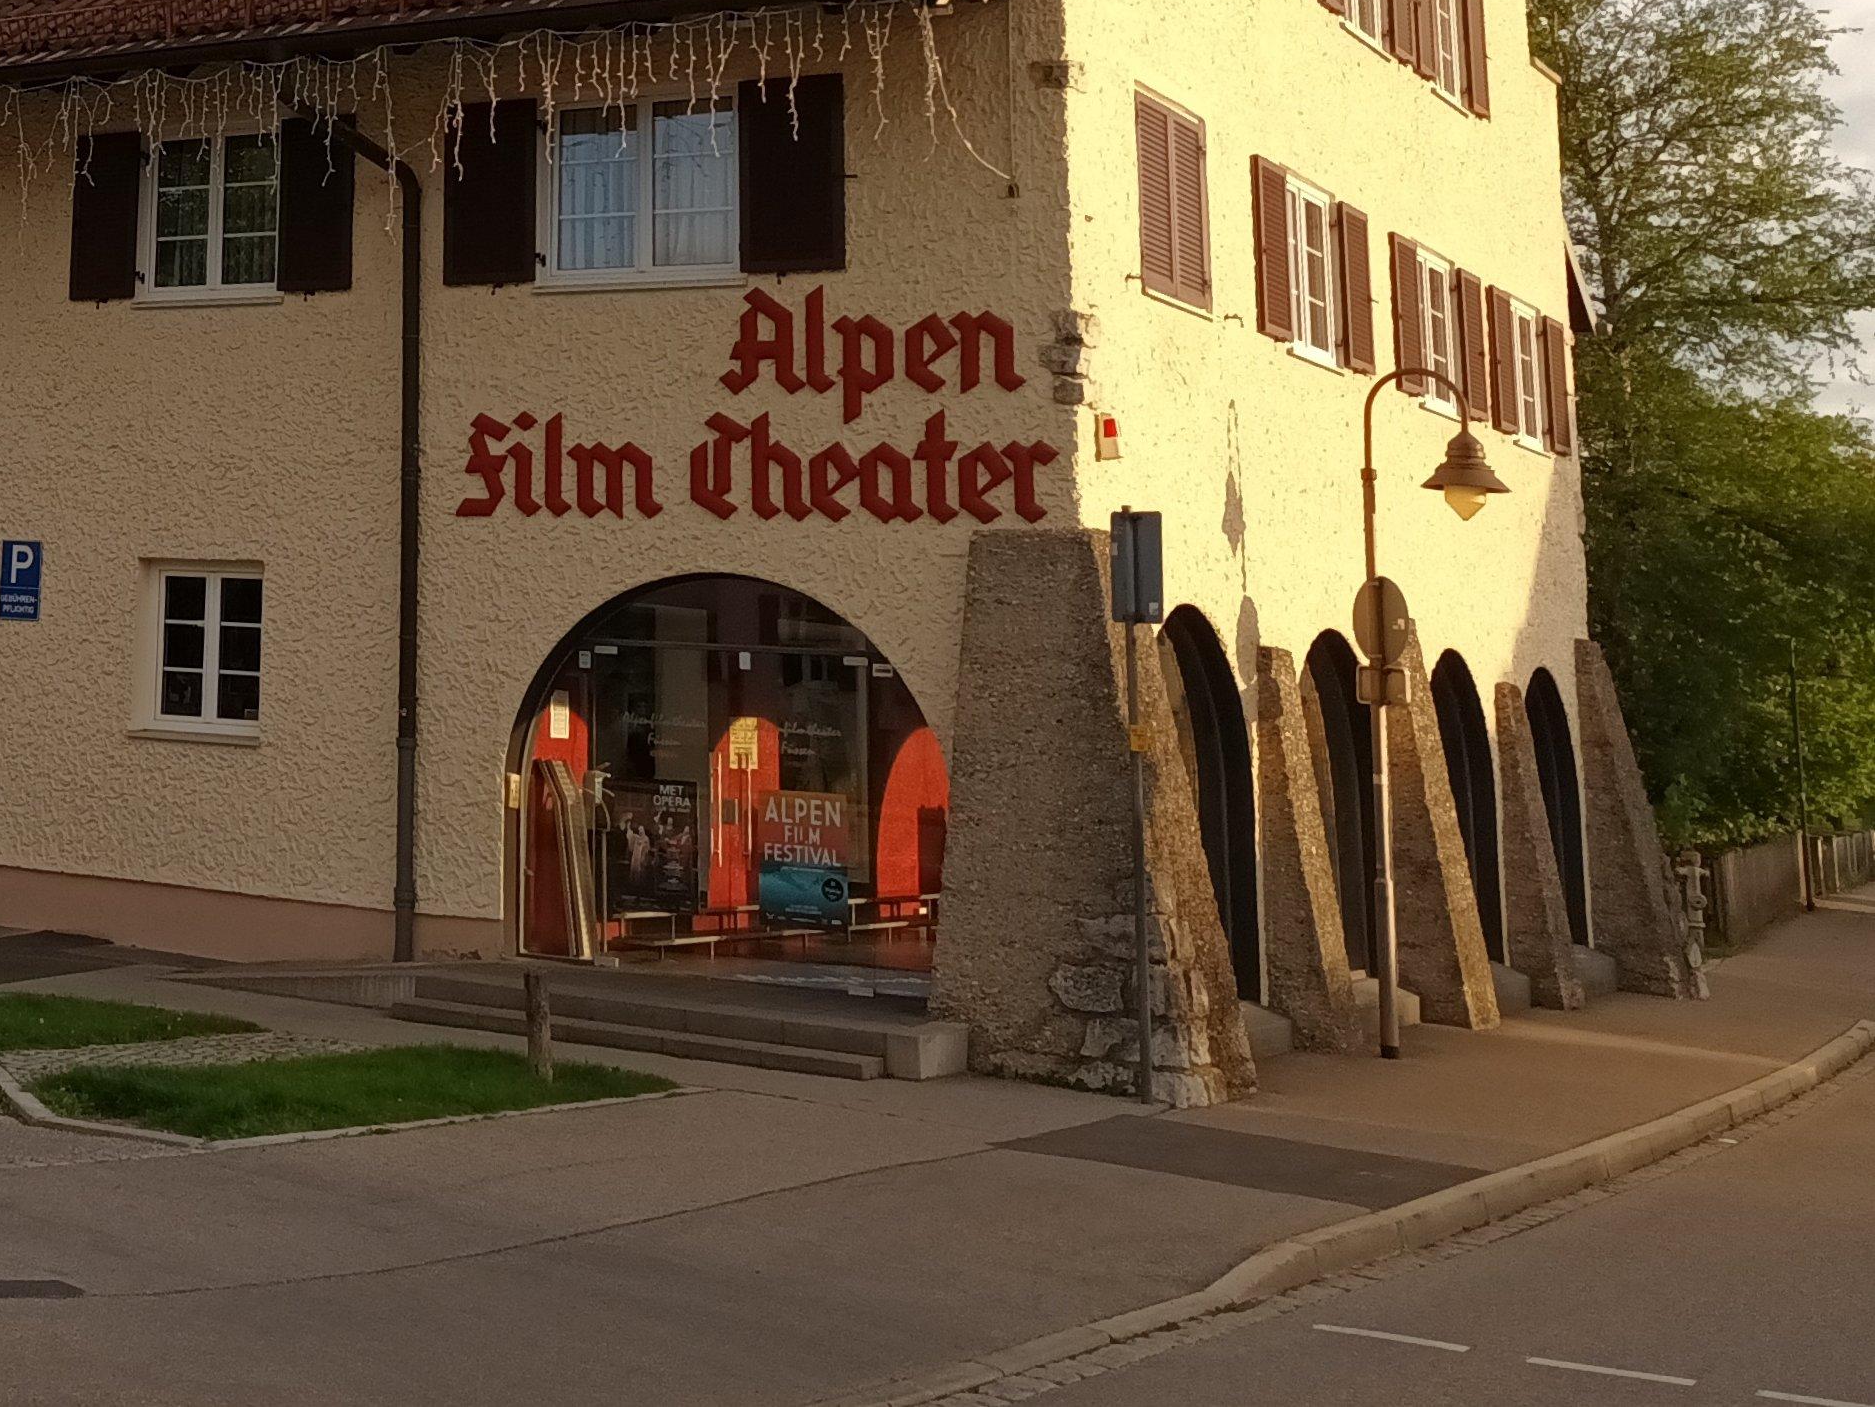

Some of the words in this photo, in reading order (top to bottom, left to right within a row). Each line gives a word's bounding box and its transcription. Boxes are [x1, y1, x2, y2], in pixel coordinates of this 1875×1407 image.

[719, 284, 1026, 425] Alpen
[455, 411, 664, 520] Film
[690, 409, 1060, 525] Theater
[10, 544, 34, 584] P
[653, 794, 691, 808] OPERA
[659, 784, 684, 796] MET
[764, 796, 841, 827] ALPEN
[784, 824, 821, 845] FILM
[764, 841, 842, 867] FESTIVAL
